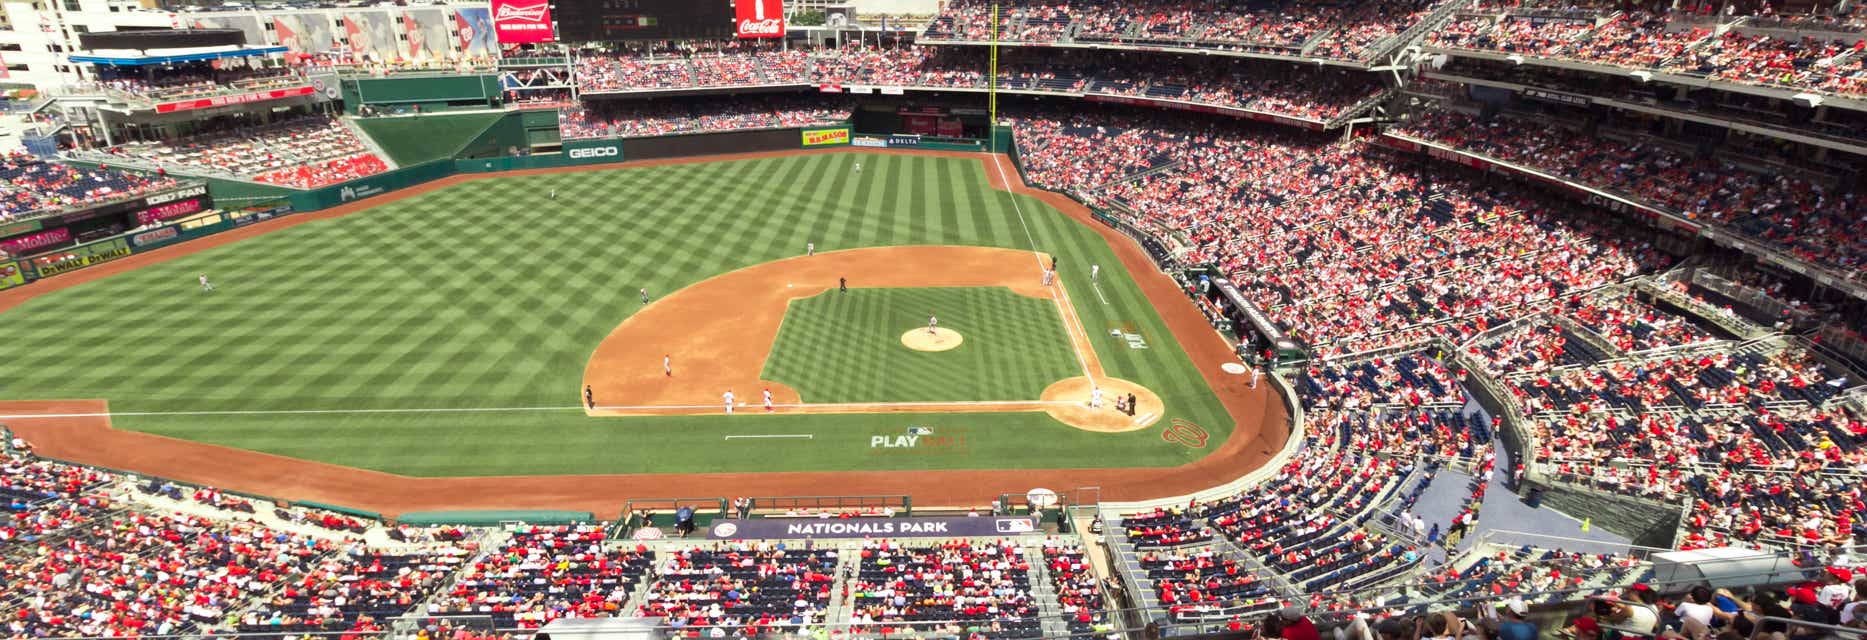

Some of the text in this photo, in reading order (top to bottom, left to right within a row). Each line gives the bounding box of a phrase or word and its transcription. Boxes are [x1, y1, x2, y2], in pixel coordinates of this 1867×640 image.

[740, 19, 781, 34] Coca-Cola
[569, 146, 618, 159] GEICO
[177, 186, 206, 199] FAN
[871, 435, 919, 448] PLAY
[788, 521, 948, 534] NATIONALS PARK
